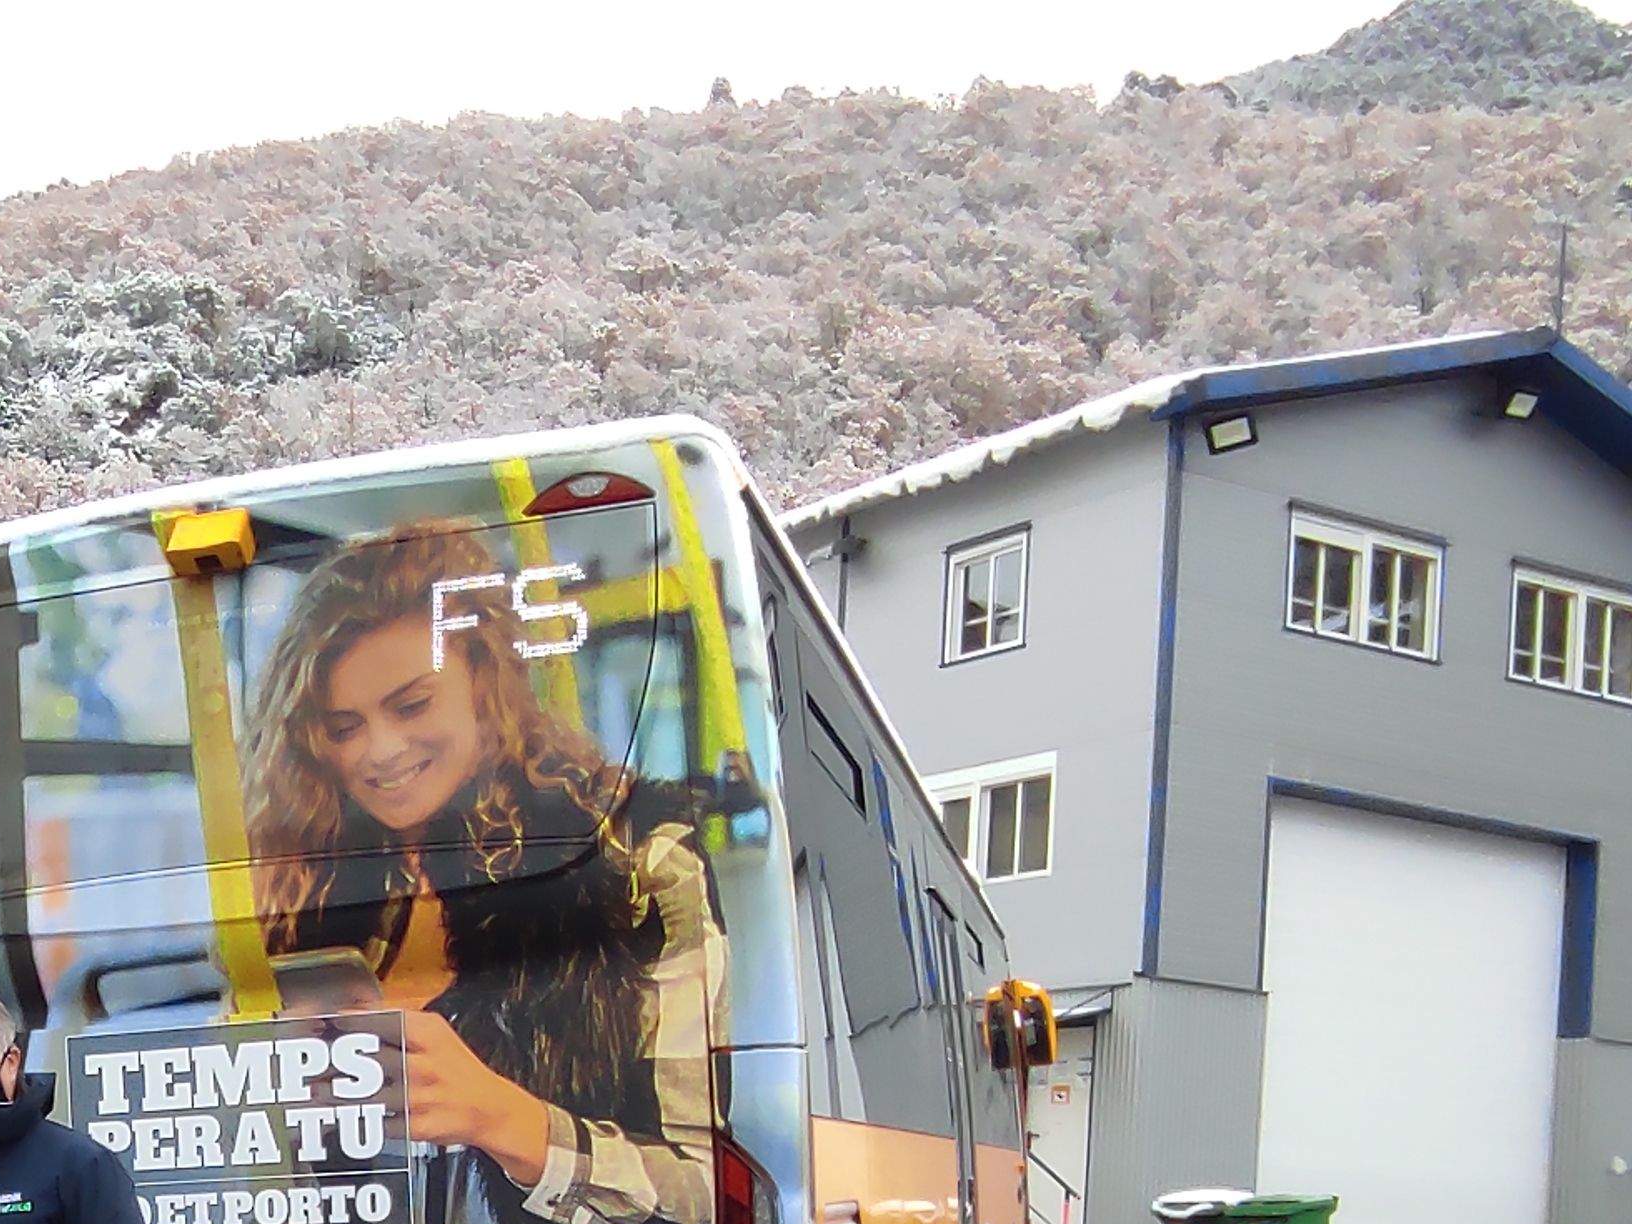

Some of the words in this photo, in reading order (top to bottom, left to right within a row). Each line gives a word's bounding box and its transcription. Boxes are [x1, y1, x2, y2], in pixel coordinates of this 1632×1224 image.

[84, 1033, 385, 1115] TEMPS
[231, 1110, 282, 1165] A
[285, 1103, 386, 1162] TU
